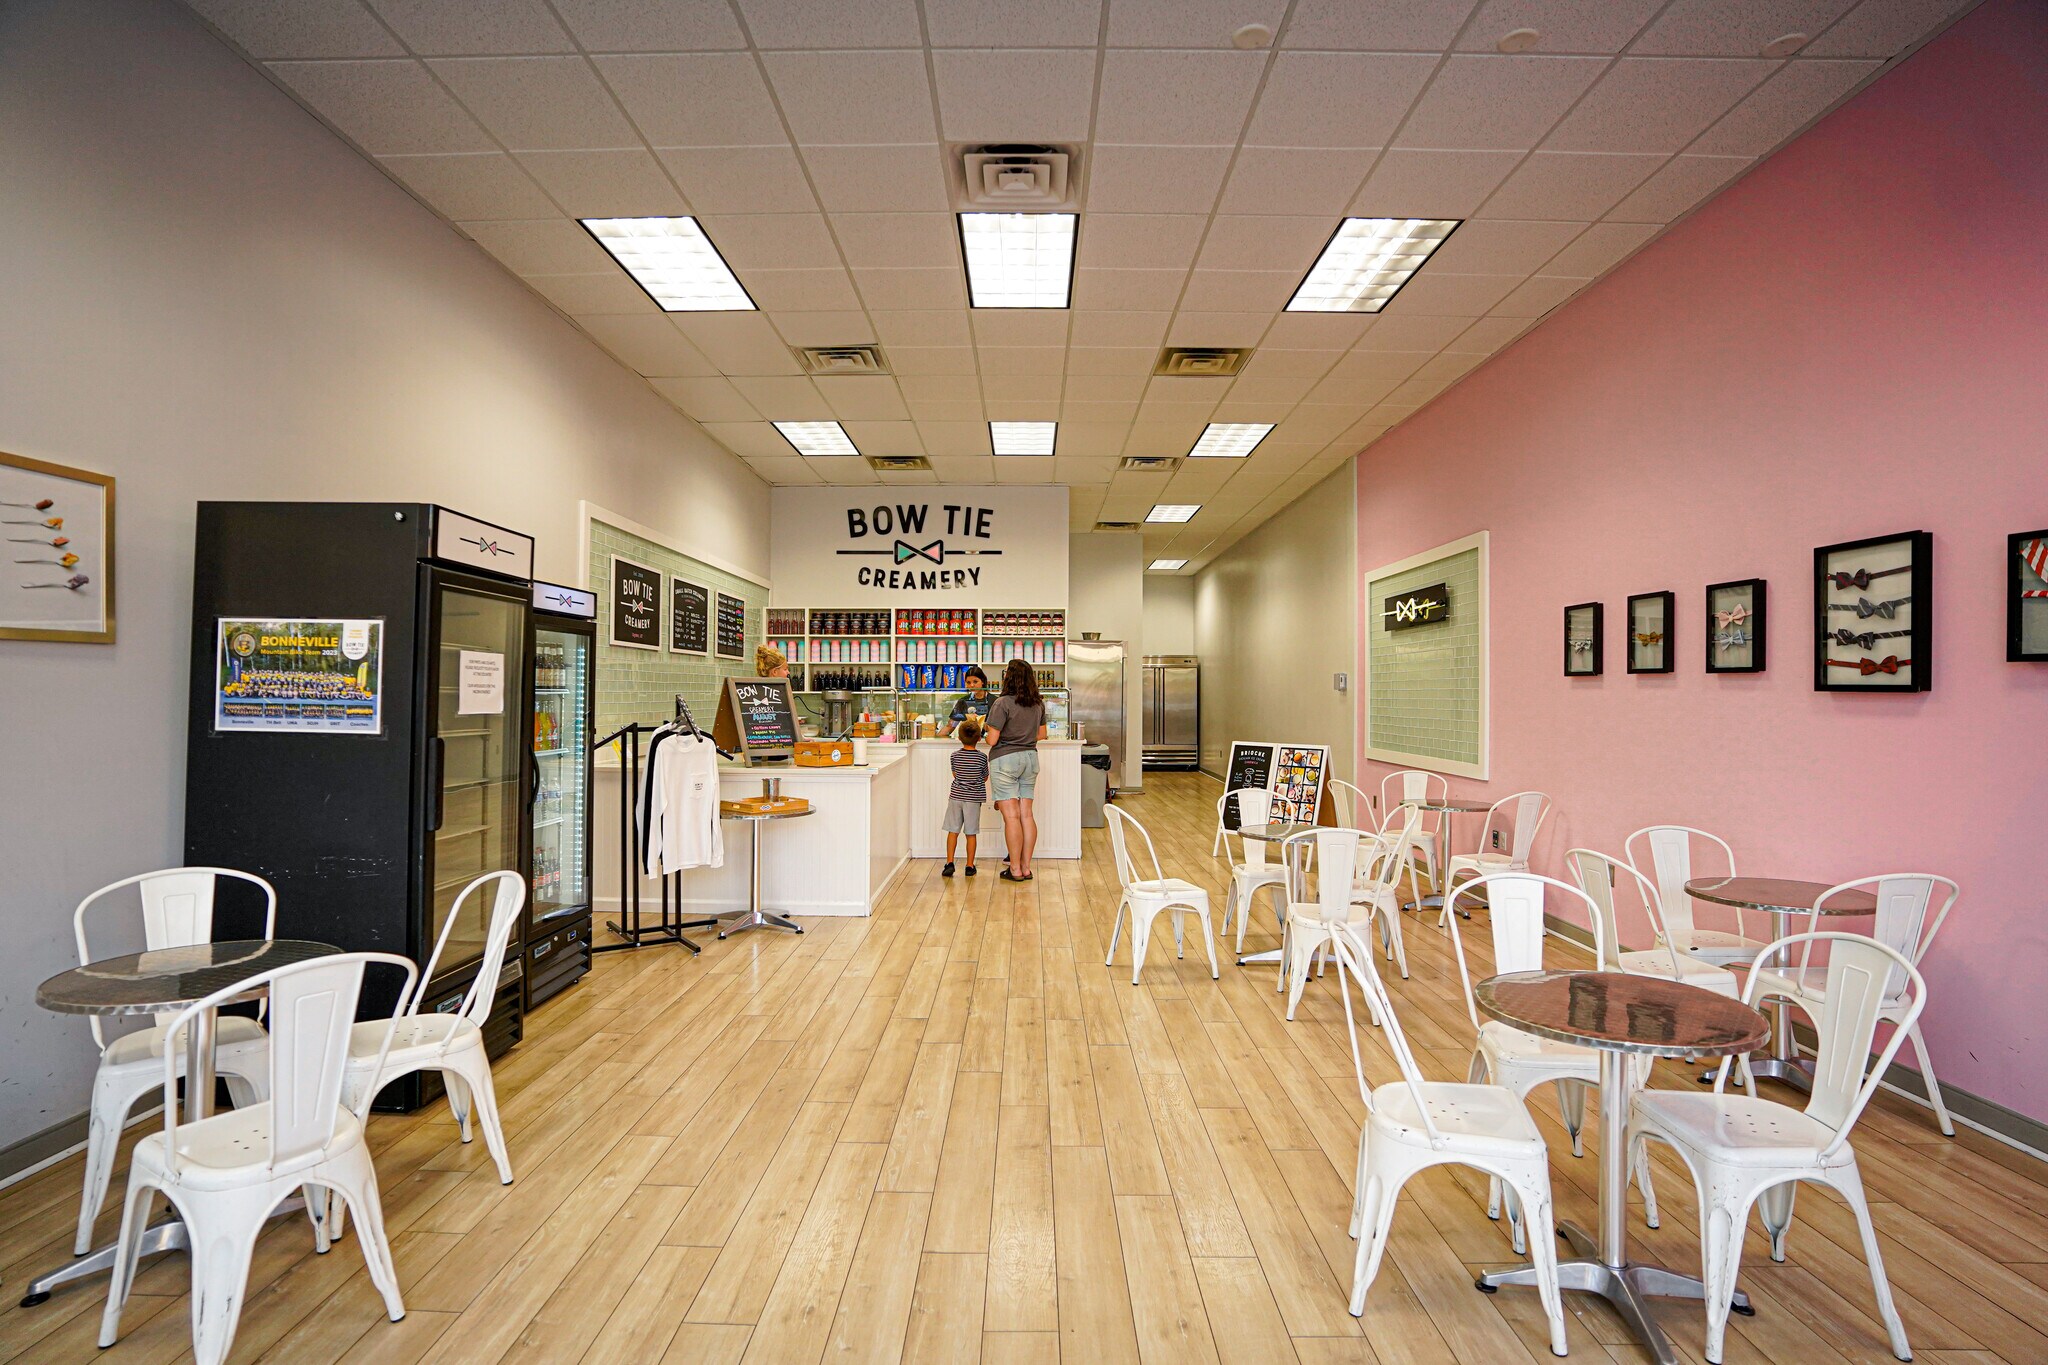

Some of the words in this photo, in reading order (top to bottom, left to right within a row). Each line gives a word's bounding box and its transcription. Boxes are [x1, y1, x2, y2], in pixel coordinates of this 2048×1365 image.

[847, 504, 928, 538] BOW
[943, 504, 994, 538] TIE
[858, 566, 980, 590] CREAMERY
[623, 579, 640, 596] BOW
[642, 583, 653, 602] TIE
[625, 614, 650, 629] CREAMERY
[261, 636, 338, 647] BONNEVILLE
[736, 684, 758, 700] BOW
[762, 685, 782, 702] TIE
